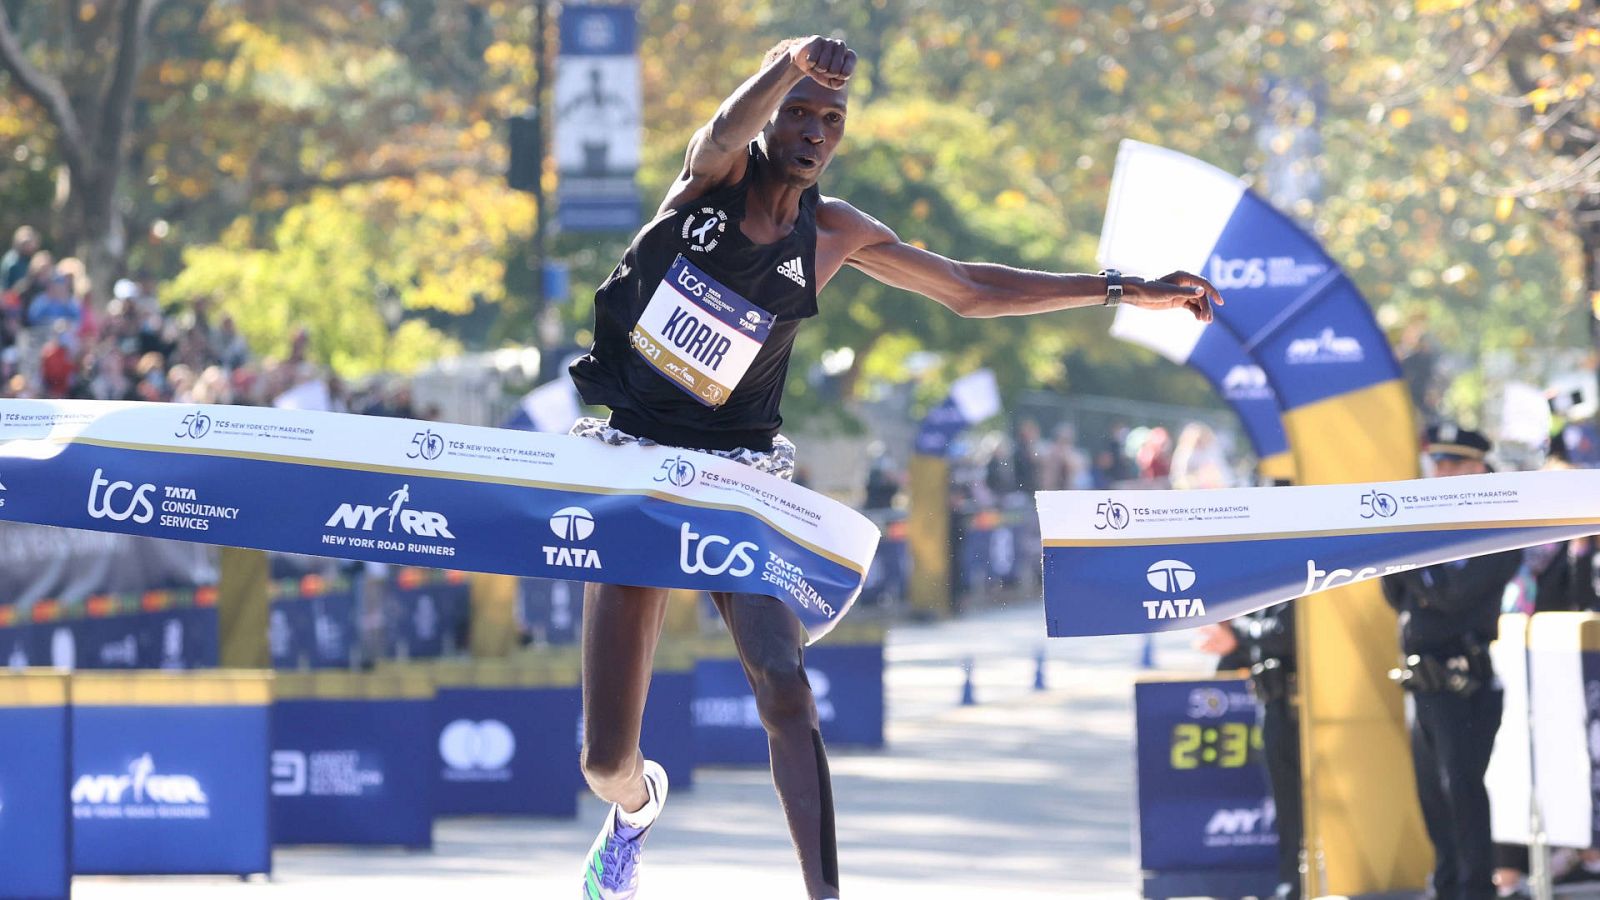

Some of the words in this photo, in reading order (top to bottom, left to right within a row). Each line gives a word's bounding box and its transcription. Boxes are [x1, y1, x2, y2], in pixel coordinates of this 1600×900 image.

[678, 265, 706, 297] tcs
[776, 265, 806, 288] adidas
[739, 317, 757, 333] TATA
[633, 331, 661, 360] 2021
[661, 305, 732, 371] KORIR
[279, 426, 314, 434] MARATHON
[449, 441, 465, 449] TCS
[518, 449, 555, 458] MARATHON
[87, 468, 156, 524] tcs
[164, 486, 197, 500] TATA
[701, 470, 719, 481] TCS
[721, 477, 739, 487] NEW
[740, 482, 760, 495] YORK
[761, 491, 780, 502] CITY
[780, 499, 822, 521] MARATHON
[1478, 490, 1518, 498] MARATHON
[161, 500, 239, 519] CONSULTANCY
[324, 502, 456, 539] NYRR
[160, 514, 209, 531] SERVICES
[322, 534, 346, 545] NEW
[348, 537, 375, 548] YORK
[377, 541, 405, 551] ROAD
[408, 544, 456, 556] RUNNERS
[680, 522, 759, 577] tcs
[542, 546, 602, 569] TATA
[768, 550, 804, 576] TATA
[761, 571, 810, 609] SERVICES
[765, 561, 836, 619] CONSULTANCY
[1142, 598, 1206, 620] TATA
